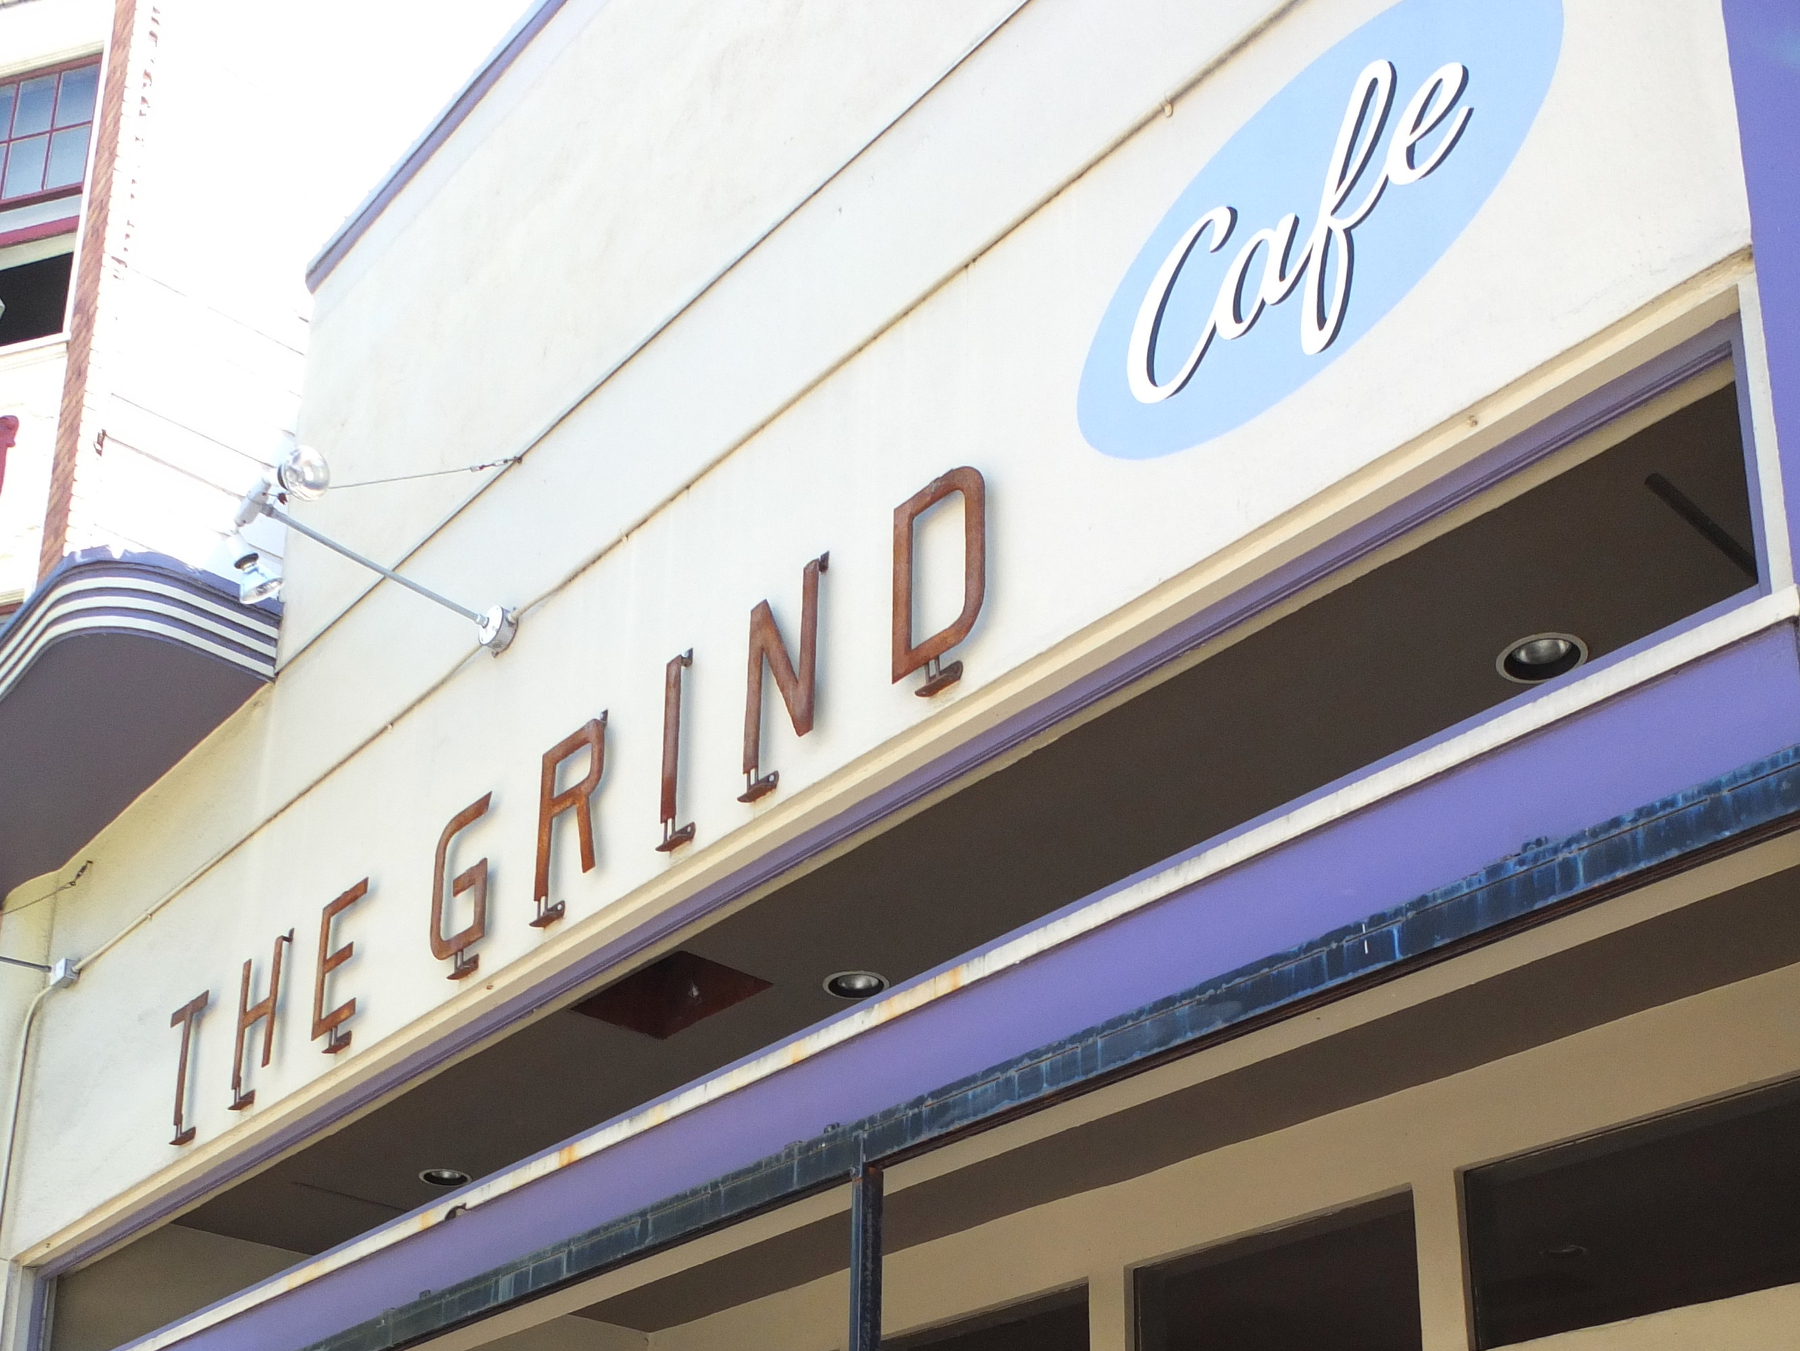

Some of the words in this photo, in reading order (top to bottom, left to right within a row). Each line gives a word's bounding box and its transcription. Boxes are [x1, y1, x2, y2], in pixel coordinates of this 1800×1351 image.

[1126, 59, 1475, 404] Cafe
[169, 876, 369, 1136] THE
[429, 466, 987, 966] GRIND
